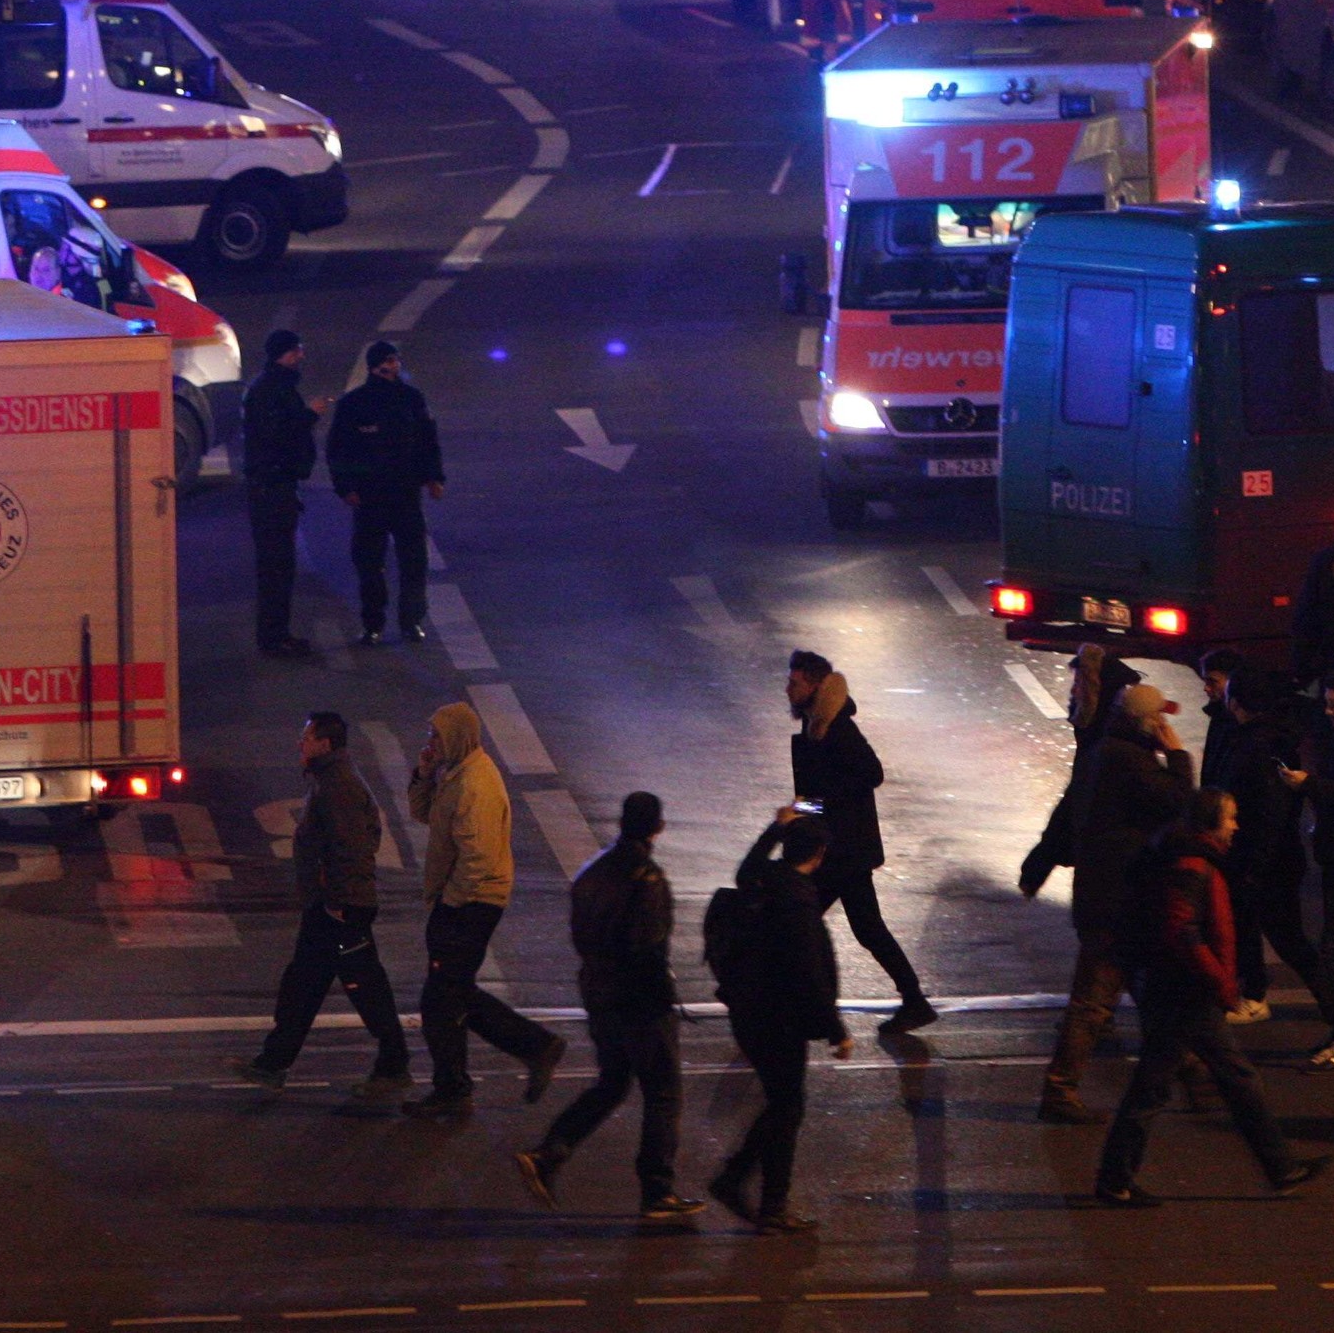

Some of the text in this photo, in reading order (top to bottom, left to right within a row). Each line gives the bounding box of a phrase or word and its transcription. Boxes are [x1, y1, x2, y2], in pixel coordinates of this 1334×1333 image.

[921, 137, 1035, 182] 112
[1051, 481, 1132, 516] POLIZEI
[1247, 474, 1271, 494] 25
